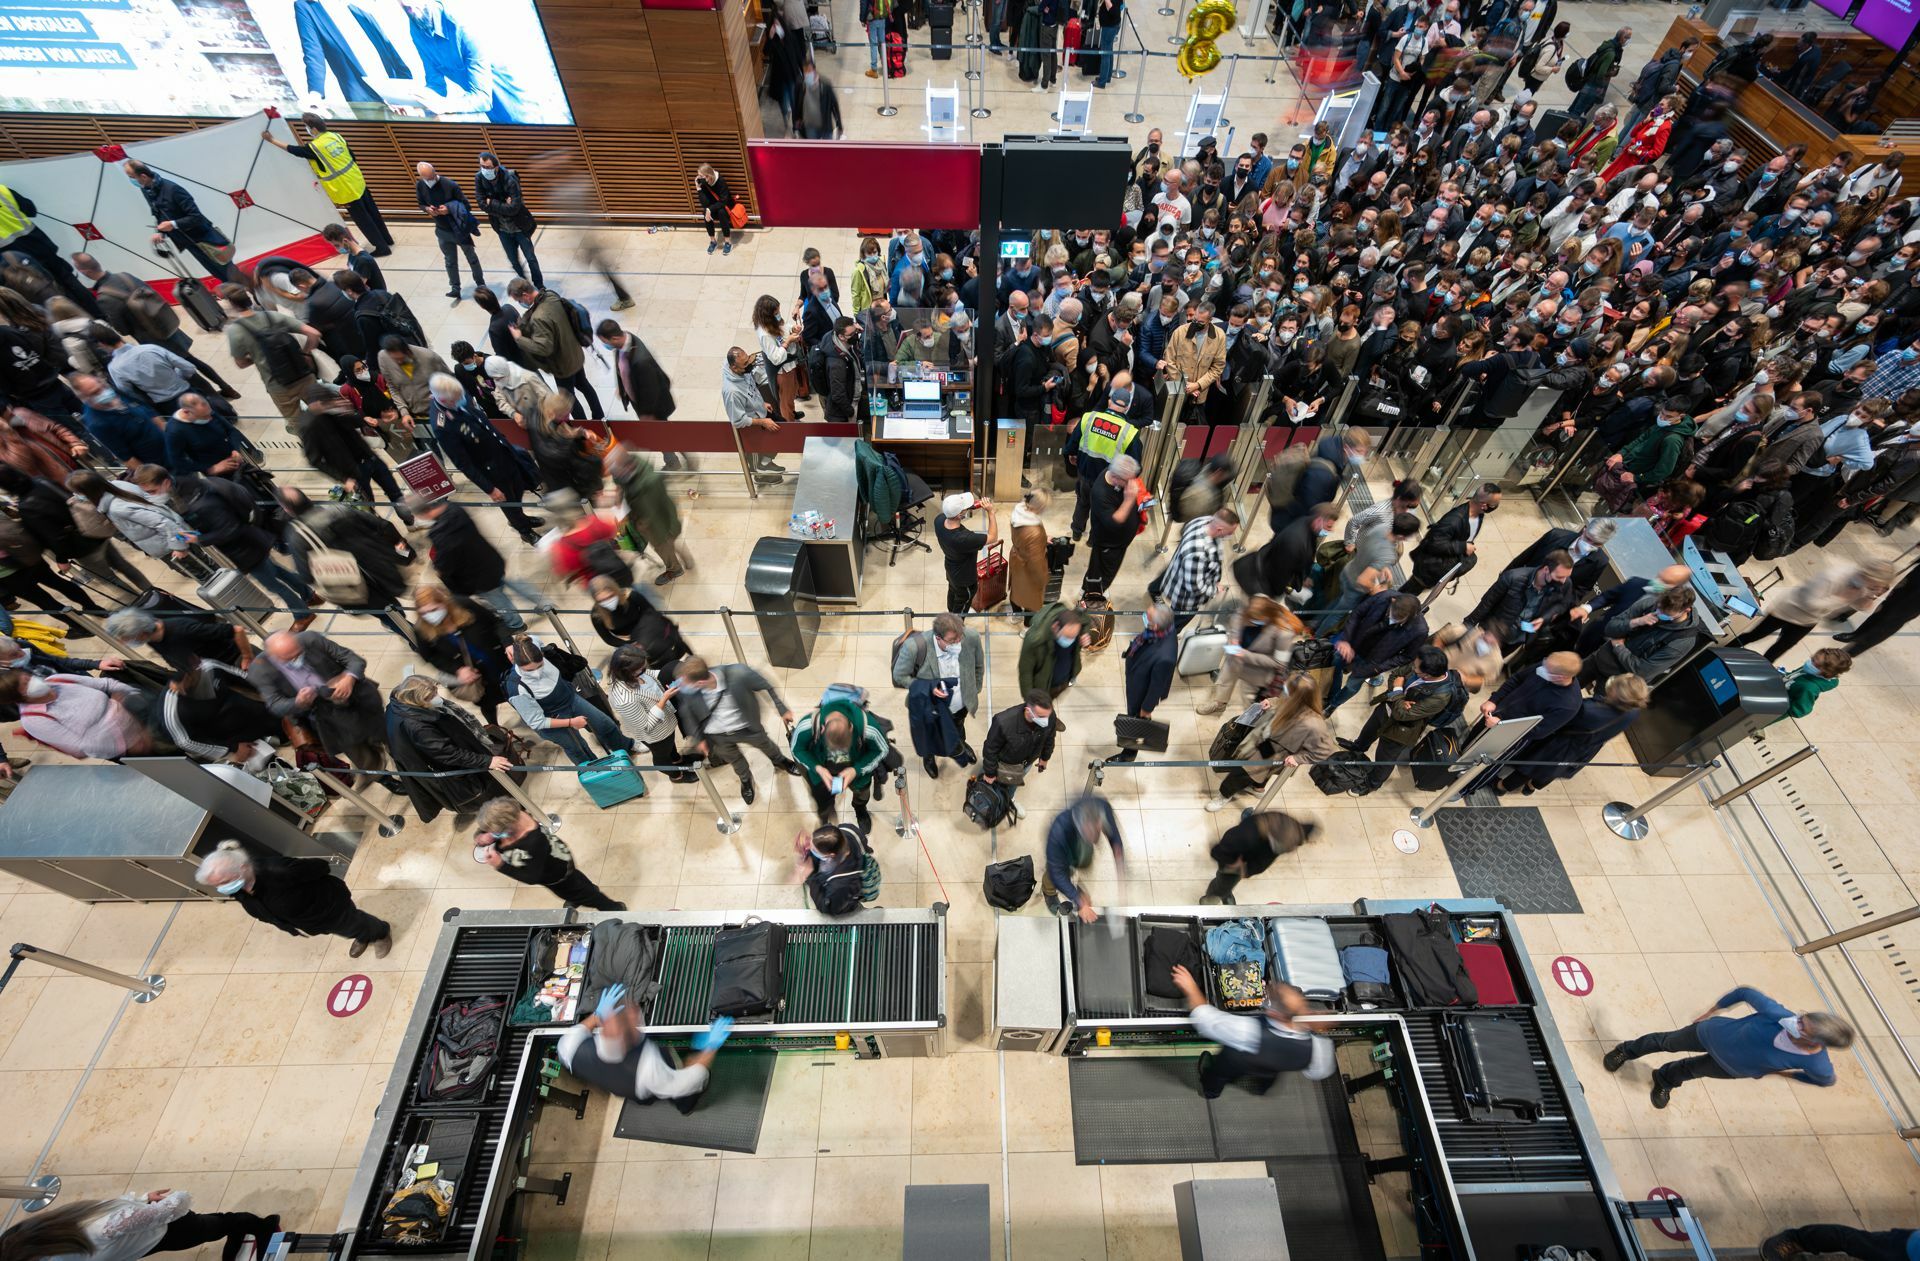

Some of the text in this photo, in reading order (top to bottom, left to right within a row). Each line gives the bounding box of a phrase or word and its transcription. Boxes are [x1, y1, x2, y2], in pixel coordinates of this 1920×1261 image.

[9, 16, 88, 33] DIGITALEN
[42, 47, 80, 63] VON
[74, 48, 128, 65] DATEV.
[1376, 402, 1400, 415] PUMA
[1092, 426, 1117, 439] SECURITAS
